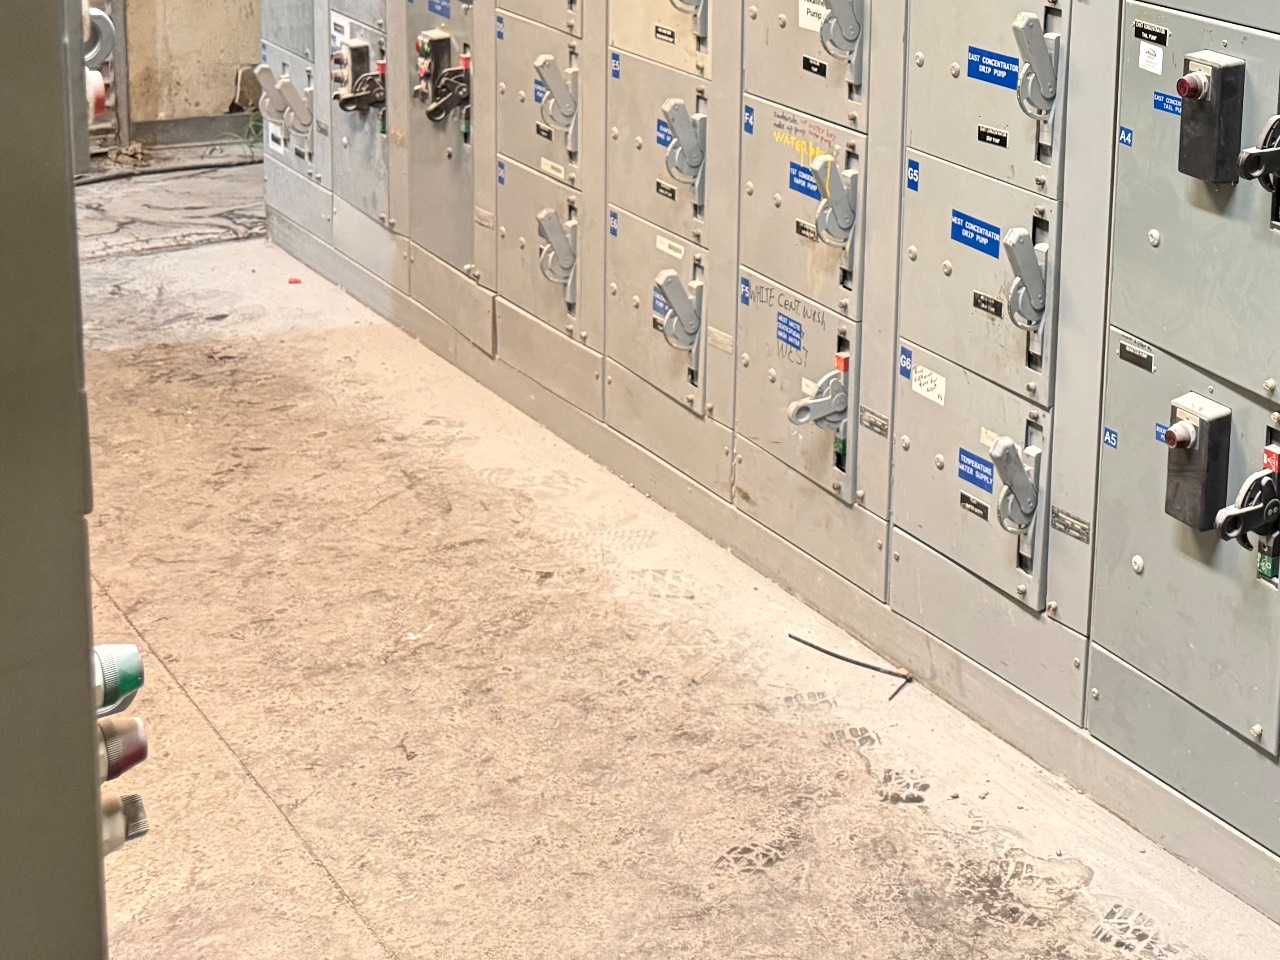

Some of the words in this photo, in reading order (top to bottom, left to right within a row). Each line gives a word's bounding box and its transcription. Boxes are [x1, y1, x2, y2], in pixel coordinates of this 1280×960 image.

[1119, 131, 1132, 144] A4
[908, 168, 919, 181] G5
[900, 355, 911, 370] G6
[1104, 433, 1117, 446] A5
[960, 454, 992, 475] TEMPERATURE
